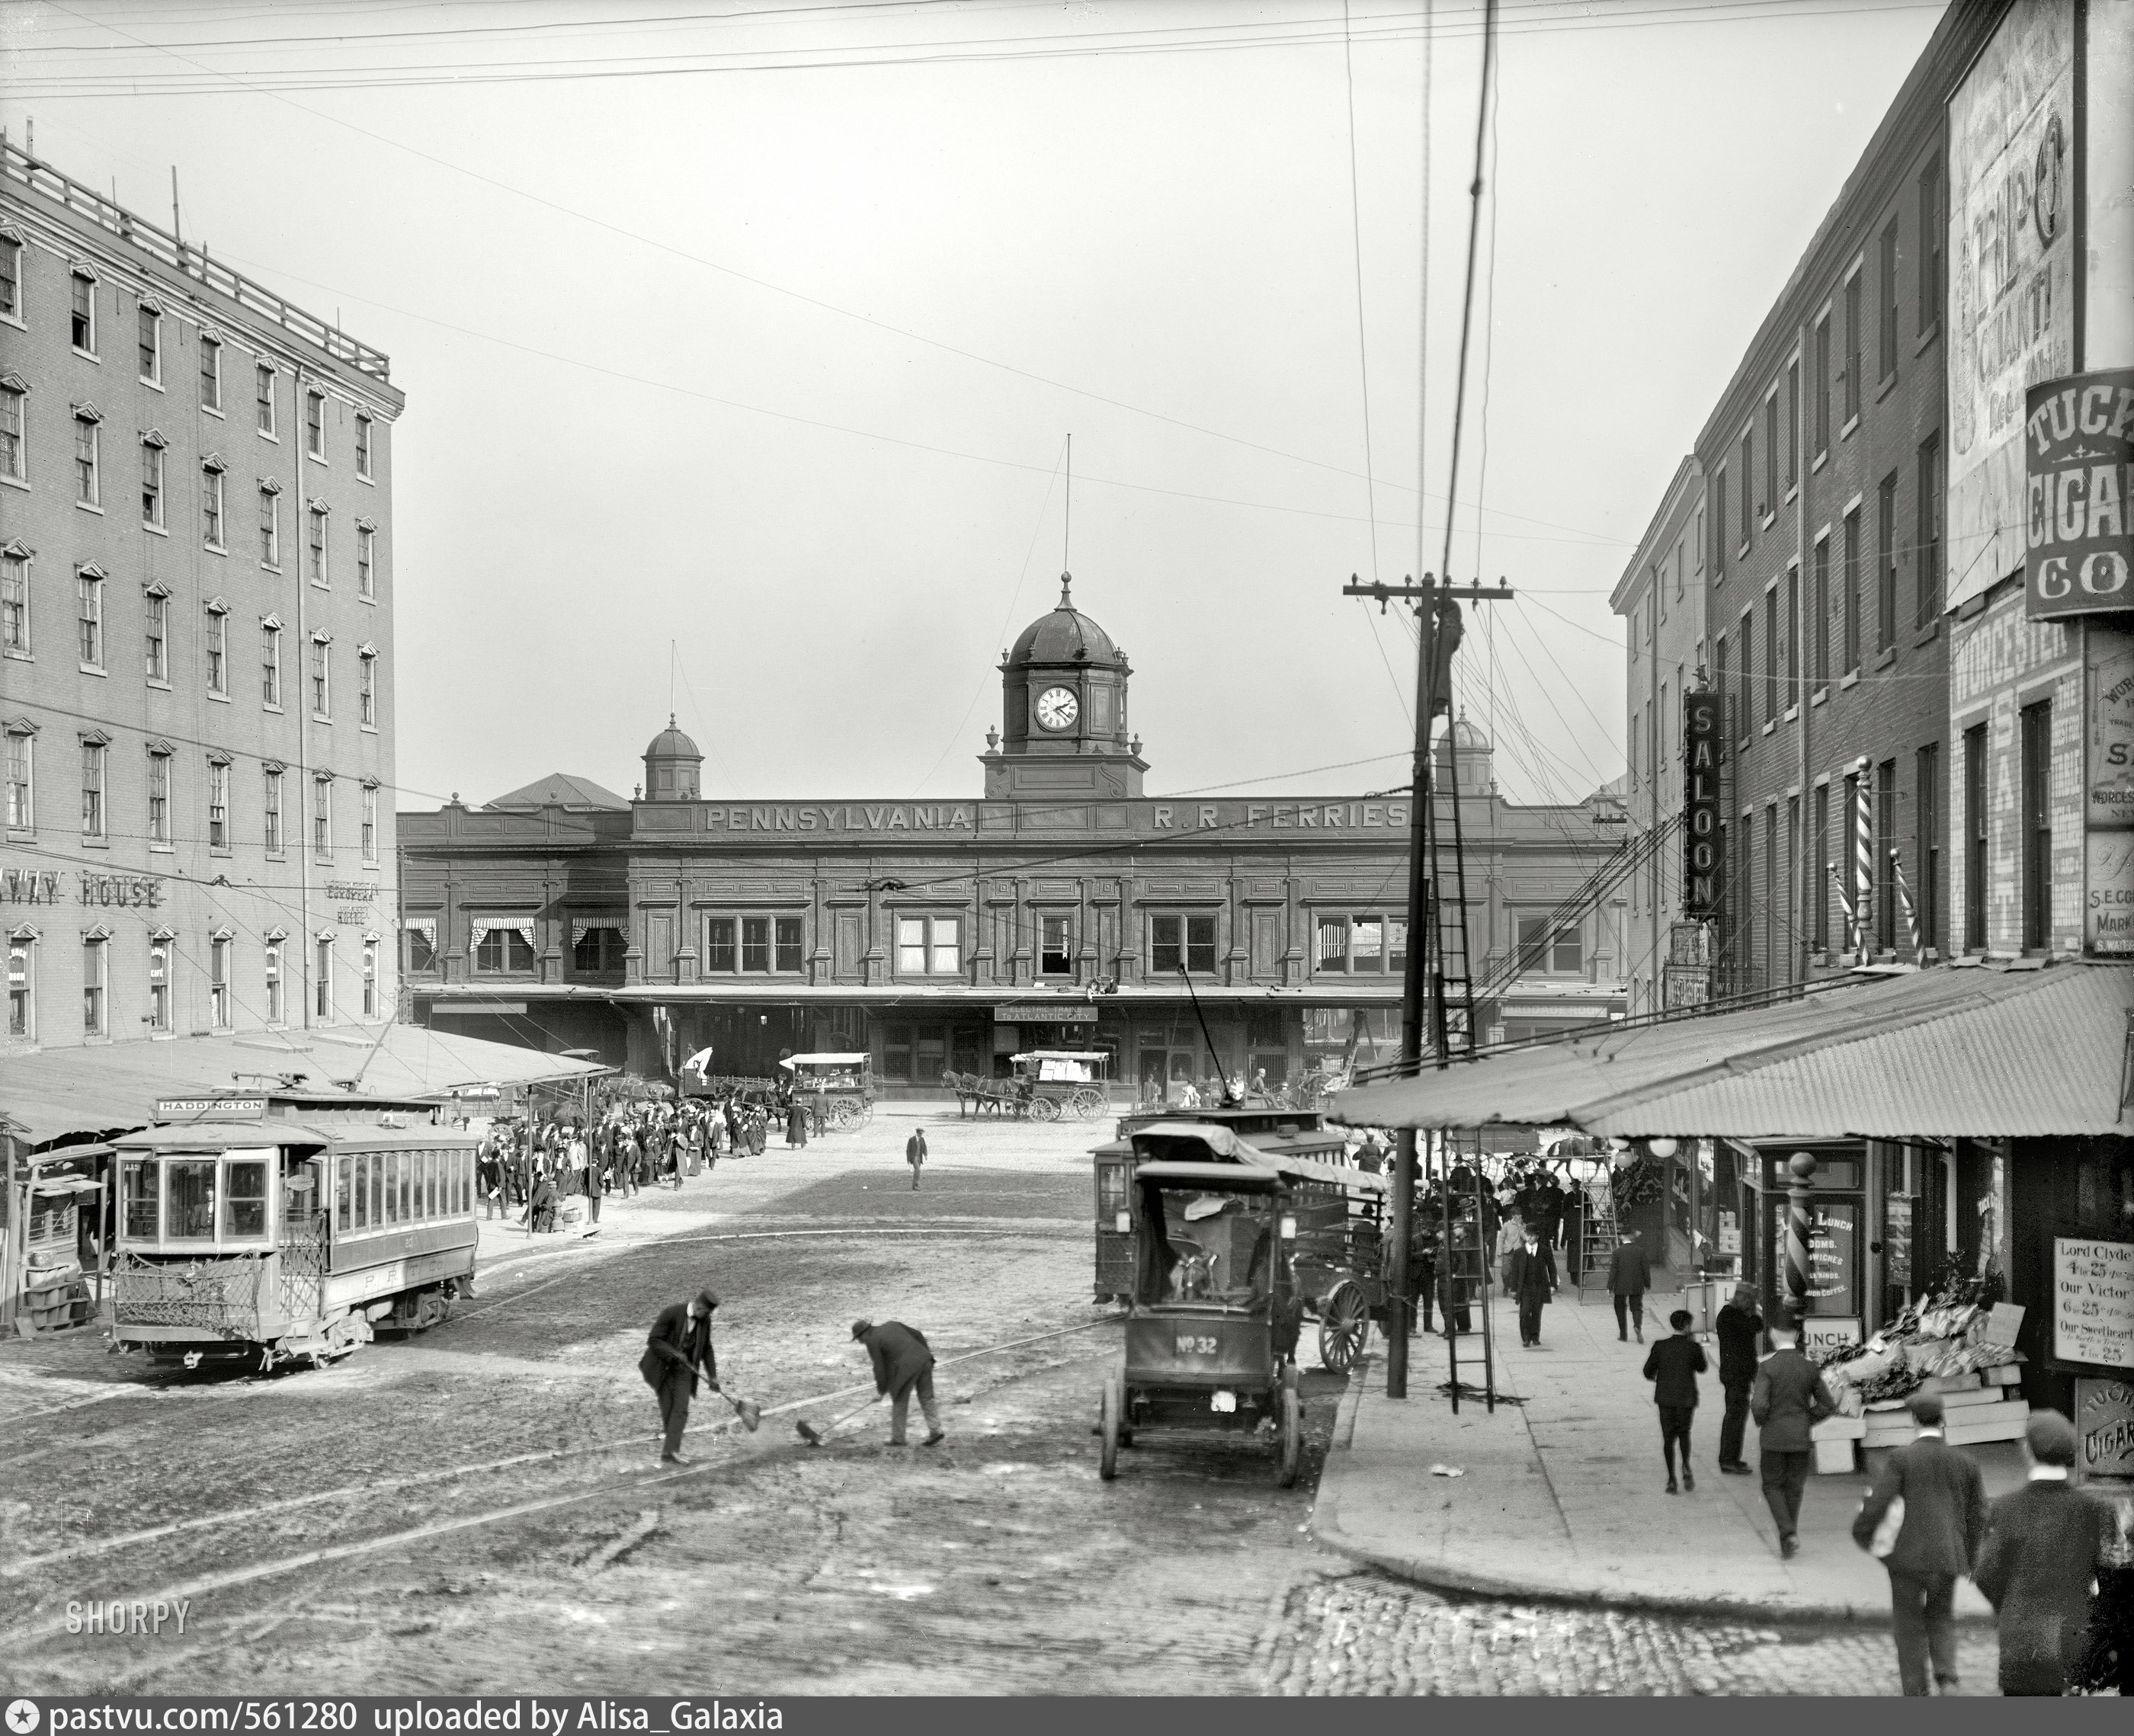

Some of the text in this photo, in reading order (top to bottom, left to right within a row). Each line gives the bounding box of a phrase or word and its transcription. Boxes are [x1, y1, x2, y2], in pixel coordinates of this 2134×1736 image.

[2027, 463, 2134, 548] CIGA
[2038, 551, 2129, 599] CO
[2104, 675, 2134, 704] WOR
[2106, 743, 2134, 765] S
[1693, 706, 1713, 905] SALOON
[1995, 688, 2014, 942] SALT
[2111, 809, 2134, 818] NE
[705, 807, 972, 831] PENNSYLVANIA
[1153, 804, 1408, 828] R. R. FERRIES
[82, 873, 165, 908] HOUSE
[163, 1101, 261, 1110] HADDINGTON
[1818, 1212, 1853, 1231] LUNCH
[1809, 1240, 1837, 1248] OOMS.
[2066, 1260, 2077, 1275] 4
[2063, 1298, 2072, 1313] 6
[1197, 1336, 1217, 1353] 32
[1806, 1333, 1848, 1346] UNCH
[2079, 1344, 2087, 1357] 7
